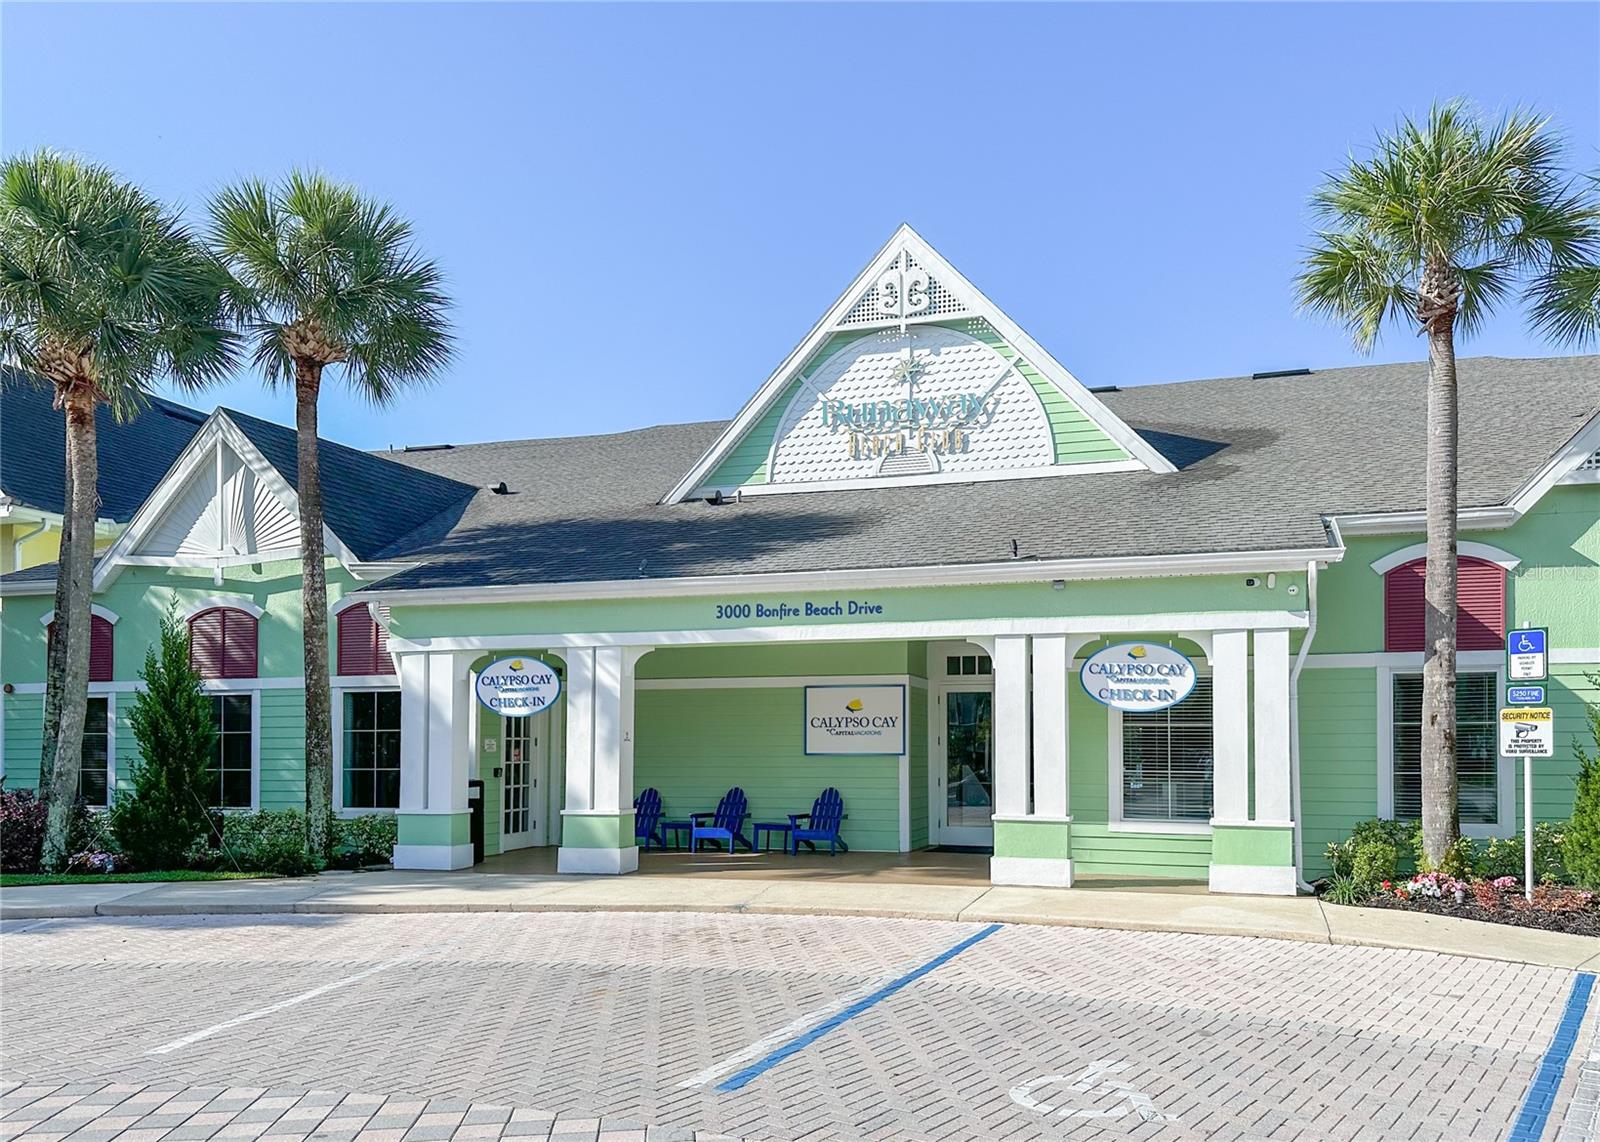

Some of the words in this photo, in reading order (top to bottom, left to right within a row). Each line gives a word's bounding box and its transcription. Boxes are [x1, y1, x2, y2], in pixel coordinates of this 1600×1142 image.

[821, 392, 987, 428] Runaway
[716, 604, 751, 619] 3000
[756, 603, 800, 620] Bonfire
[805, 601, 843, 616] Beach
[848, 600, 883, 615] Drive
[1089, 662, 1155, 675] CALYPSO
[1157, 663, 1186, 676] CAY
[481, 674, 530, 686] CALYPSO
[531, 674, 553, 685] CAY
[1098, 688, 1177, 702] CHECK-IN
[490, 697, 545, 708] CHECK-IN
[810, 716, 870, 728] CALYPSO
[872, 716, 898, 728] CAY
[1502, 712, 1529, 720] SECURITY
[1530, 711, 1551, 719] NOTICE
